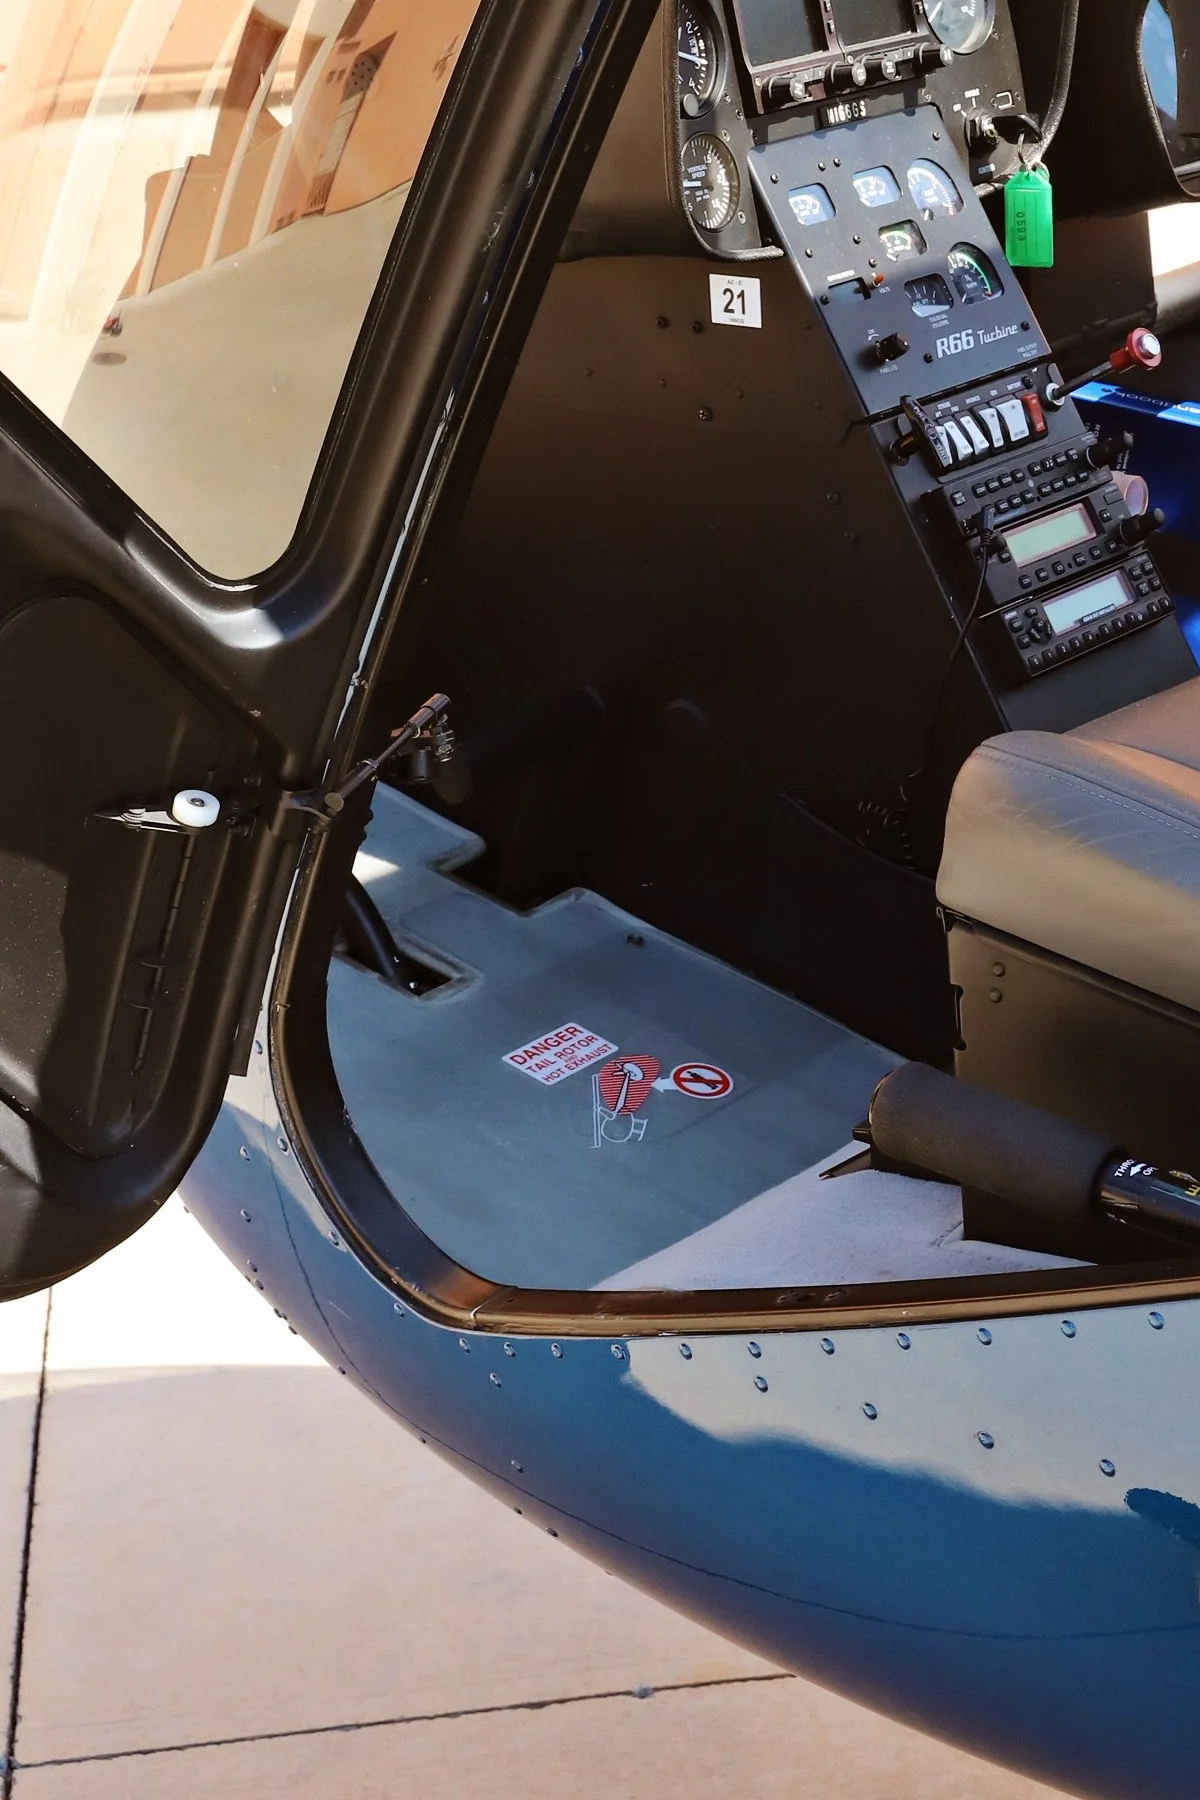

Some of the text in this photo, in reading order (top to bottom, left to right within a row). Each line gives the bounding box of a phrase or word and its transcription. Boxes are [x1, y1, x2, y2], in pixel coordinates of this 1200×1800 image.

[687, 164, 708, 174] VERTICAL
[722, 287, 746, 316] 21
[935, 324, 1019, 359] R66 Turbine
[509, 1026, 584, 1065] DANGER
[525, 1034, 599, 1074] TAIL ROTOR
[543, 1043, 612, 1083] HOT EXHAUST
